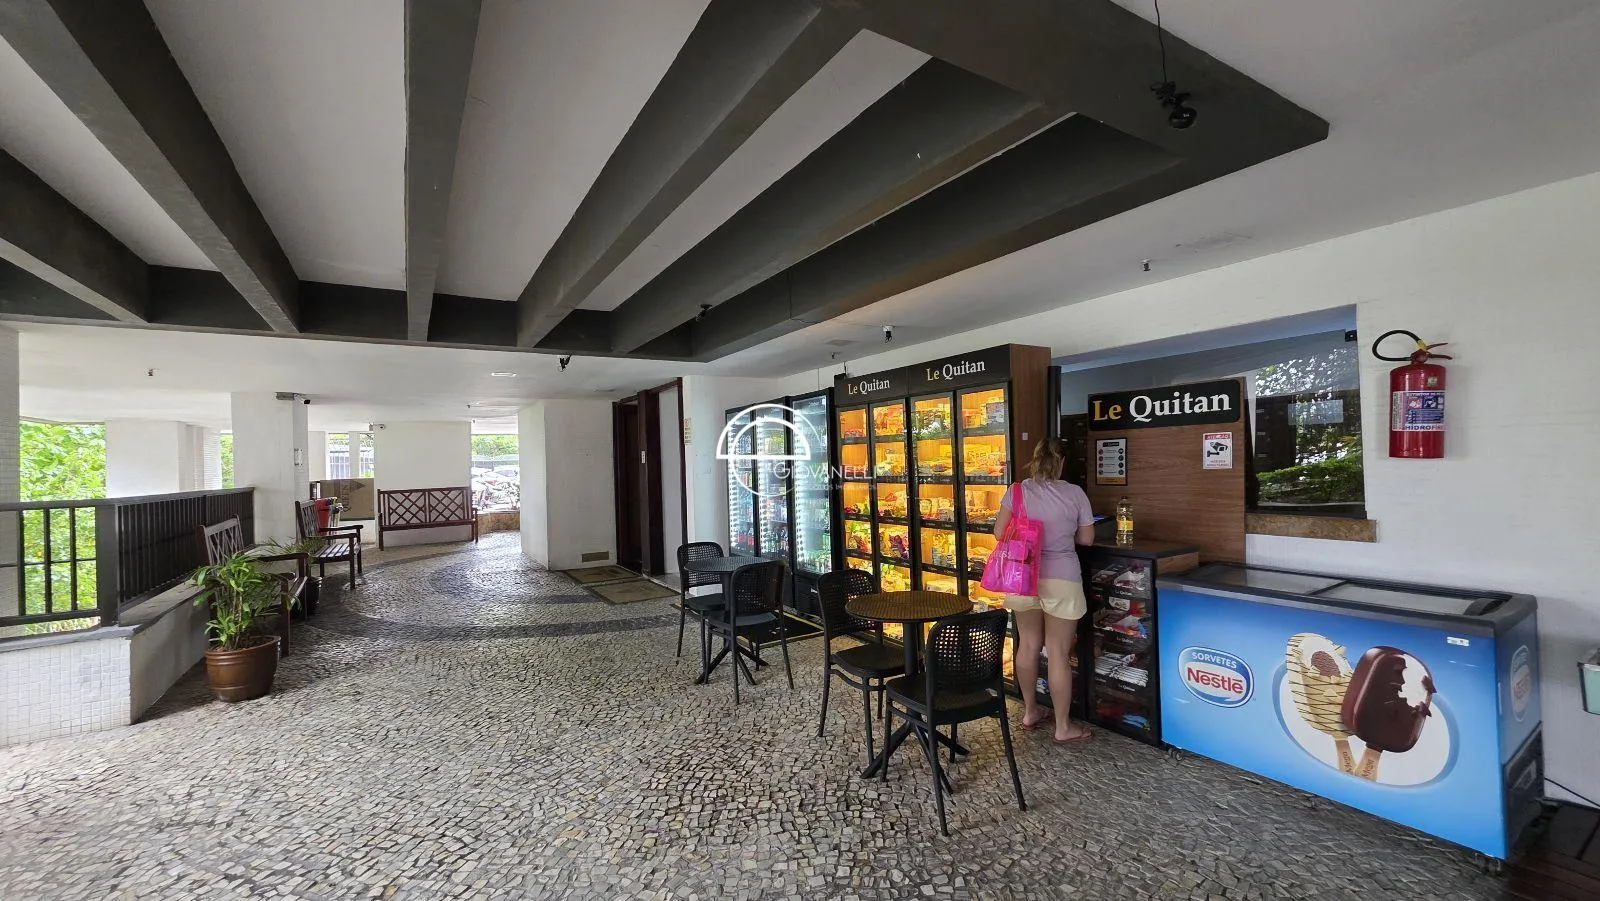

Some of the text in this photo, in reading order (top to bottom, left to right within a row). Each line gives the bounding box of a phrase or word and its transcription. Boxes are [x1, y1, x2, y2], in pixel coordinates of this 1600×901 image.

[926, 360, 986, 381] Le Quitan
[848, 379, 890, 395] Le Quitan
[1092, 391, 1232, 423] Le Quitan
[1191, 651, 1237, 669] SORVETES
[1187, 666, 1244, 694] Nestlé
